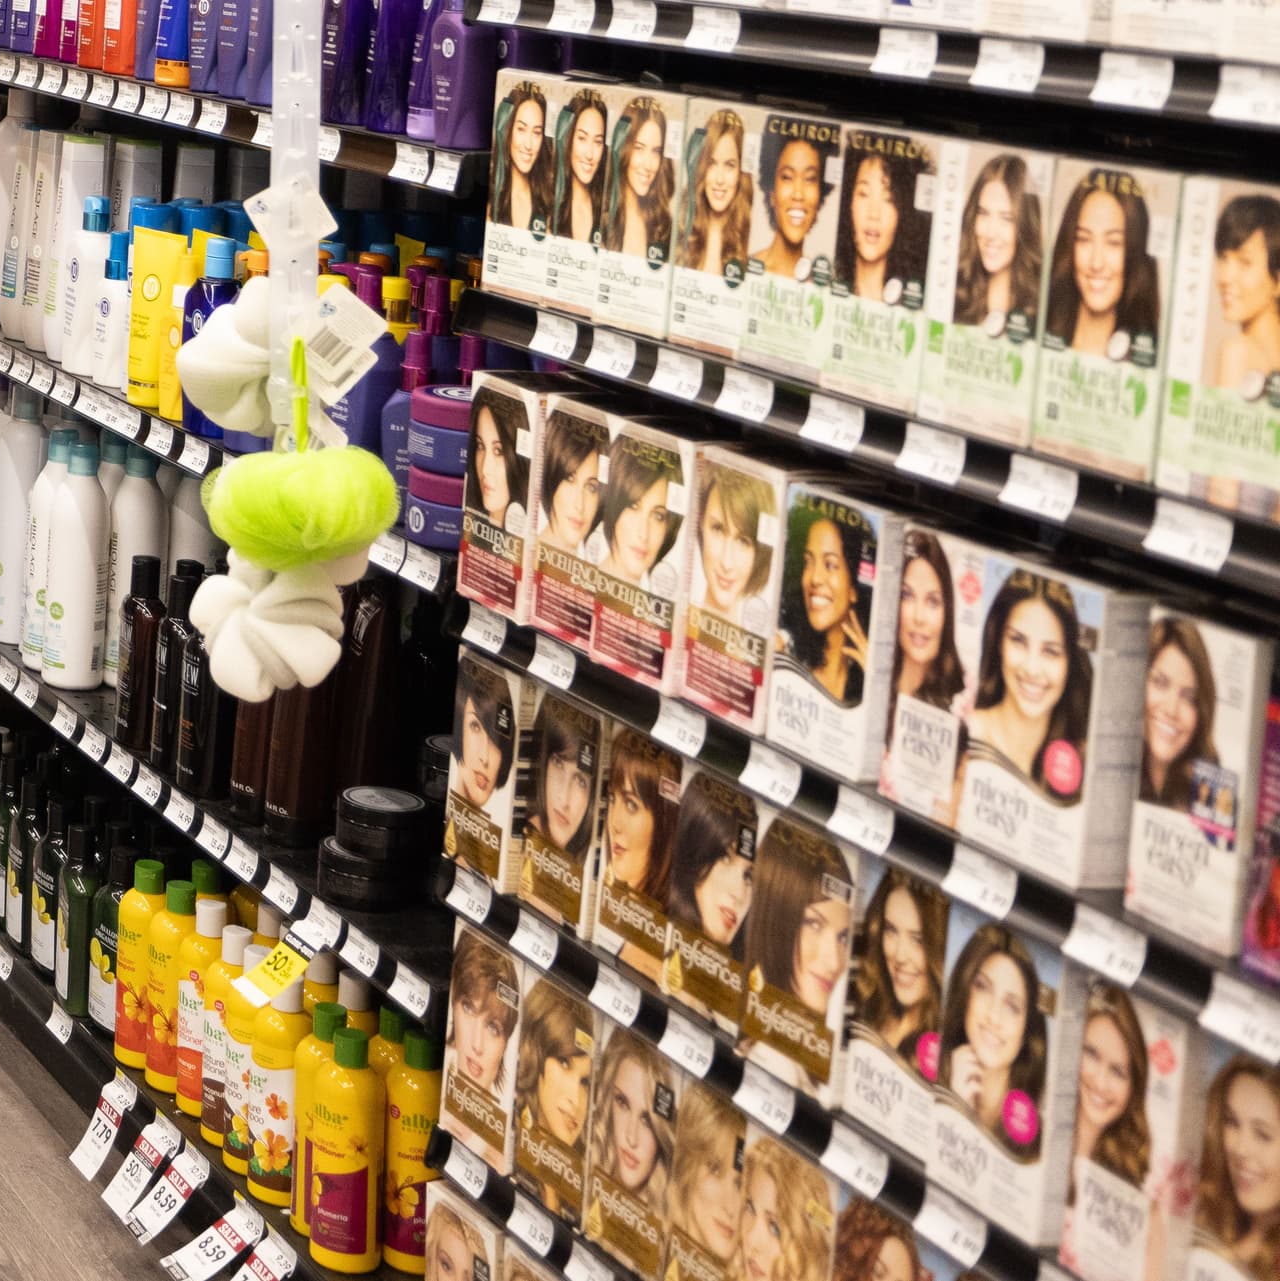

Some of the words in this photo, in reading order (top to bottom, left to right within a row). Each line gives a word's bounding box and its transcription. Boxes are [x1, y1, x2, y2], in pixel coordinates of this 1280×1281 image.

[177, 810, 192, 826] 14.99
[447, 800, 500, 851] Preference
[525, 839, 582, 891] Preference
[672, 929, 742, 993] Preference
[746, 990, 830, 1058] Preference
[101, 1099, 120, 1124] SALE
[447, 1075, 504, 1136] Preference
[138, 1138, 159, 1163] SALE
[520, 1127, 582, 1191] Preference
[153, 1185, 177, 1214] 8.59
[168, 1170, 189, 1195] SALE
[592, 1175, 658, 1244] Preference
[198, 1235, 227, 1263] 8.59
[220, 1222, 241, 1249] SALE
